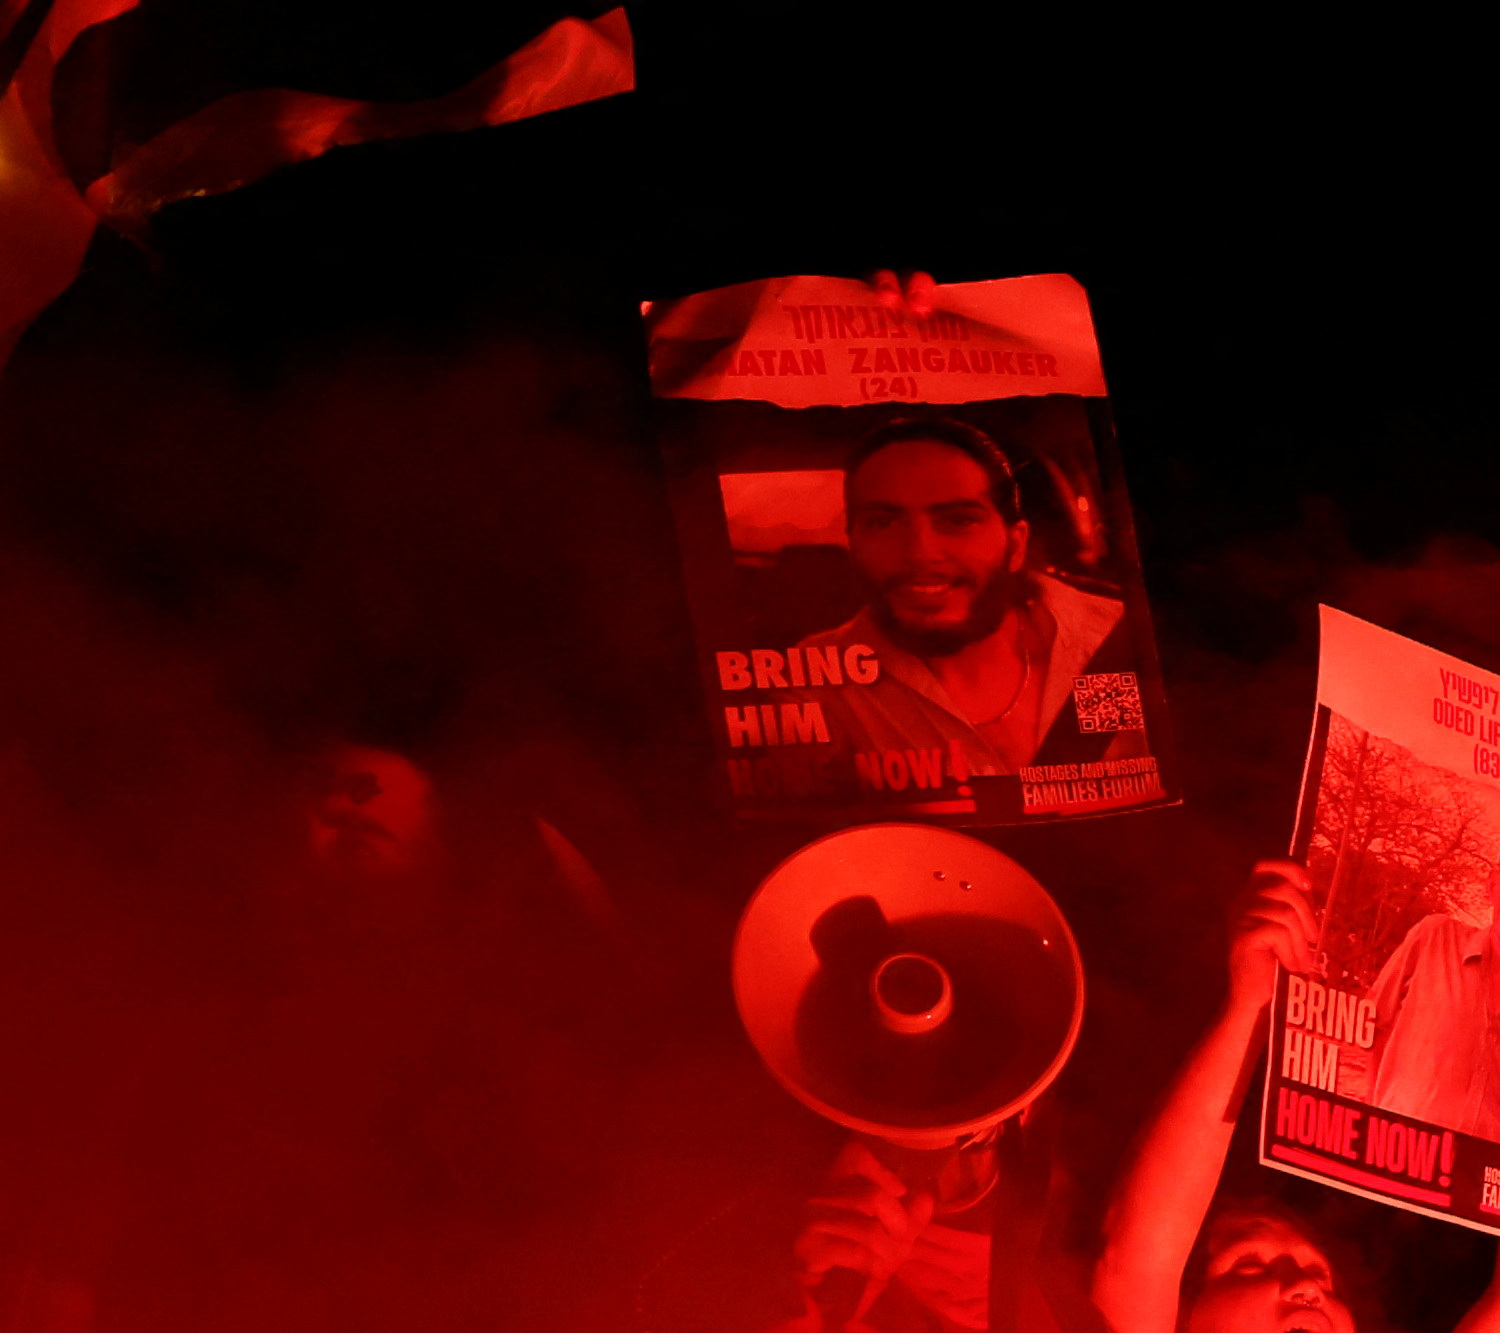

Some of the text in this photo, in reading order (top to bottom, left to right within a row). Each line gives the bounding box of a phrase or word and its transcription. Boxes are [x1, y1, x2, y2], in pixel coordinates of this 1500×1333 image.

[849, 347, 1058, 378] ZANGAUKER
[859, 376, 918, 400] (24)
[714, 643, 880, 691] BRING
[1439, 666, 1500, 715] ליפשיץ
[723, 701, 831, 748] HIM
[1433, 697, 1475, 737] ODED
[854, 739, 974, 798] NOW!
[1019, 763, 1079, 783] HOSTAGES
[1105, 757, 1157, 777] MISSING
[1022, 772, 1161, 807] FAMILIES FORUM
[1286, 974, 1377, 1049] BRING
[1281, 1026, 1339, 1094] HIM
[1276, 1086, 1453, 1188] HOME NOW!
